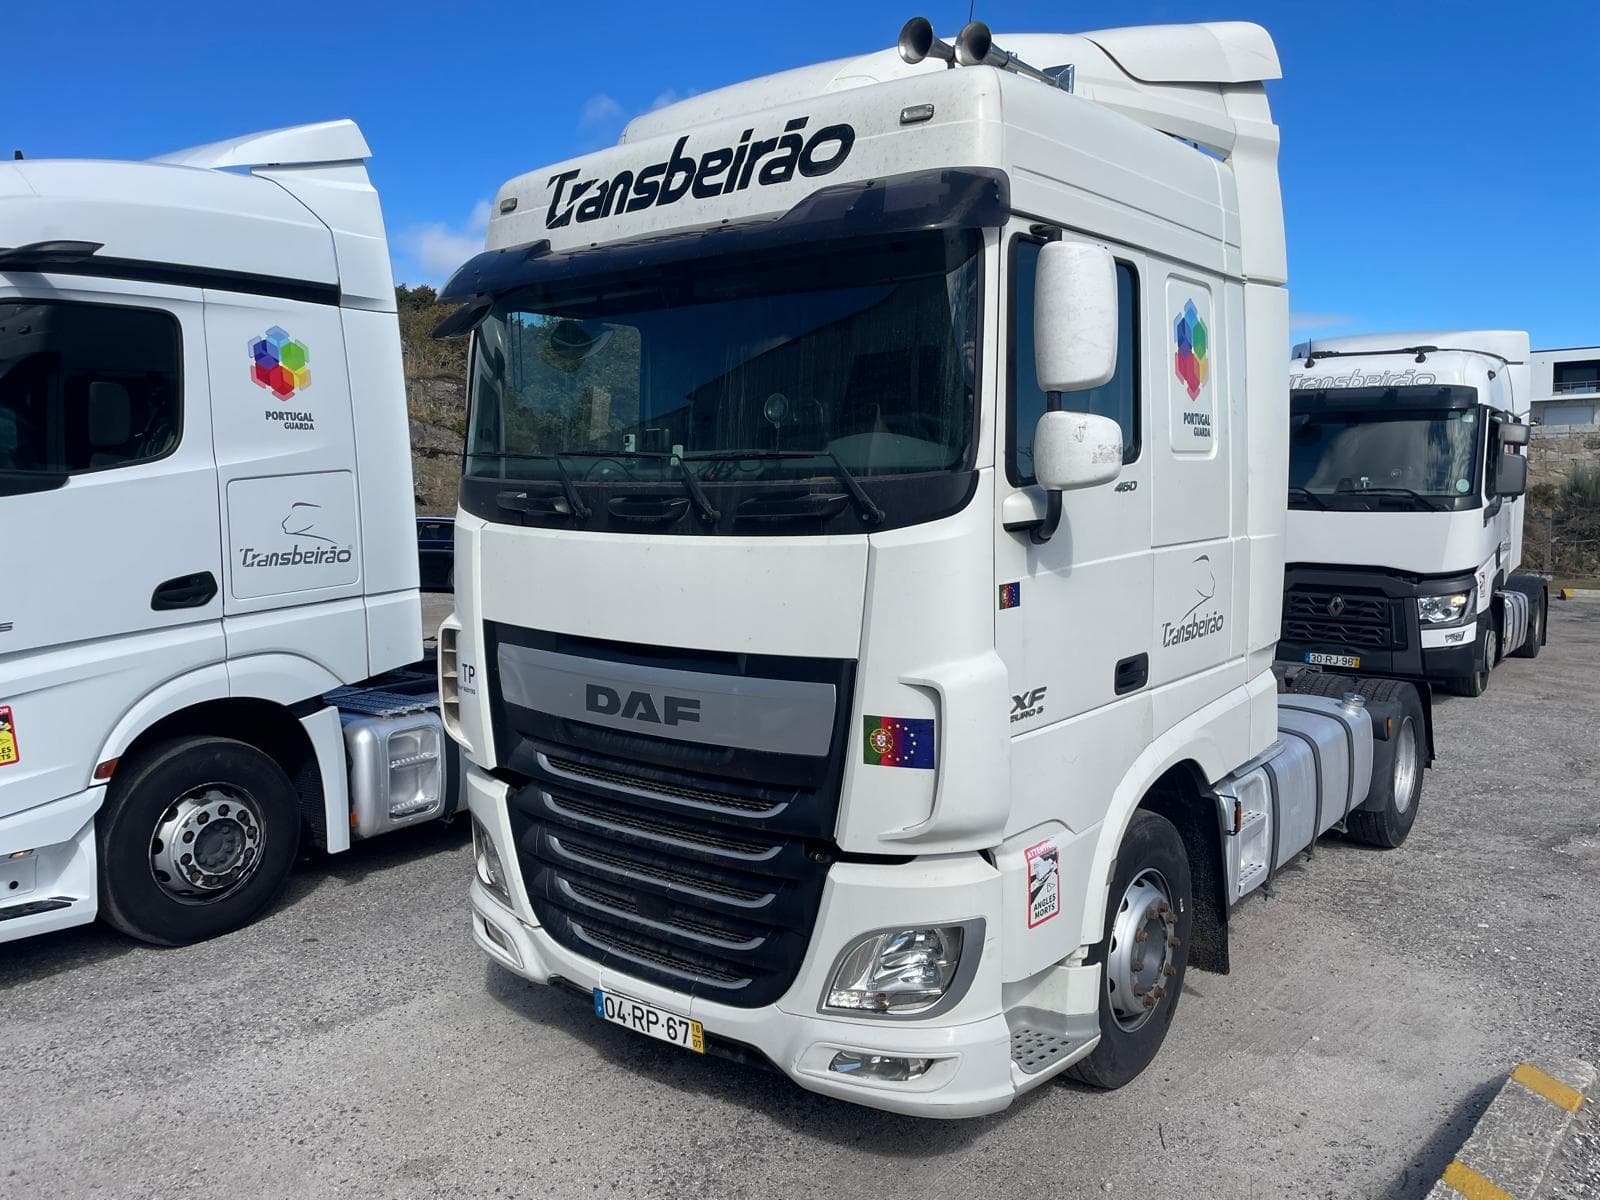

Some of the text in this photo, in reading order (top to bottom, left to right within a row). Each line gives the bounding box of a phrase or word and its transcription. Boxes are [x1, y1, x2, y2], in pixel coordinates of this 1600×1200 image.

[546, 116, 855, 230] Transbeirão
[265, 411, 314, 422] PORTUGAL
[1183, 412, 1210, 426] PORTUGAL
[284, 422, 315, 431] GUARDA
[1193, 427, 1211, 438] GUARDA
[1114, 480, 1138, 493] 460
[240, 545, 351, 568] Transbeirão
[1162, 610, 1224, 648] Transbeirão
[462, 663, 475, 684] TP
[586, 683, 701, 726] DAF
[1010, 686, 1047, 714] XF
[1033, 893, 1056, 912] ANGLES
[1034, 902, 1055, 920] MORTS
